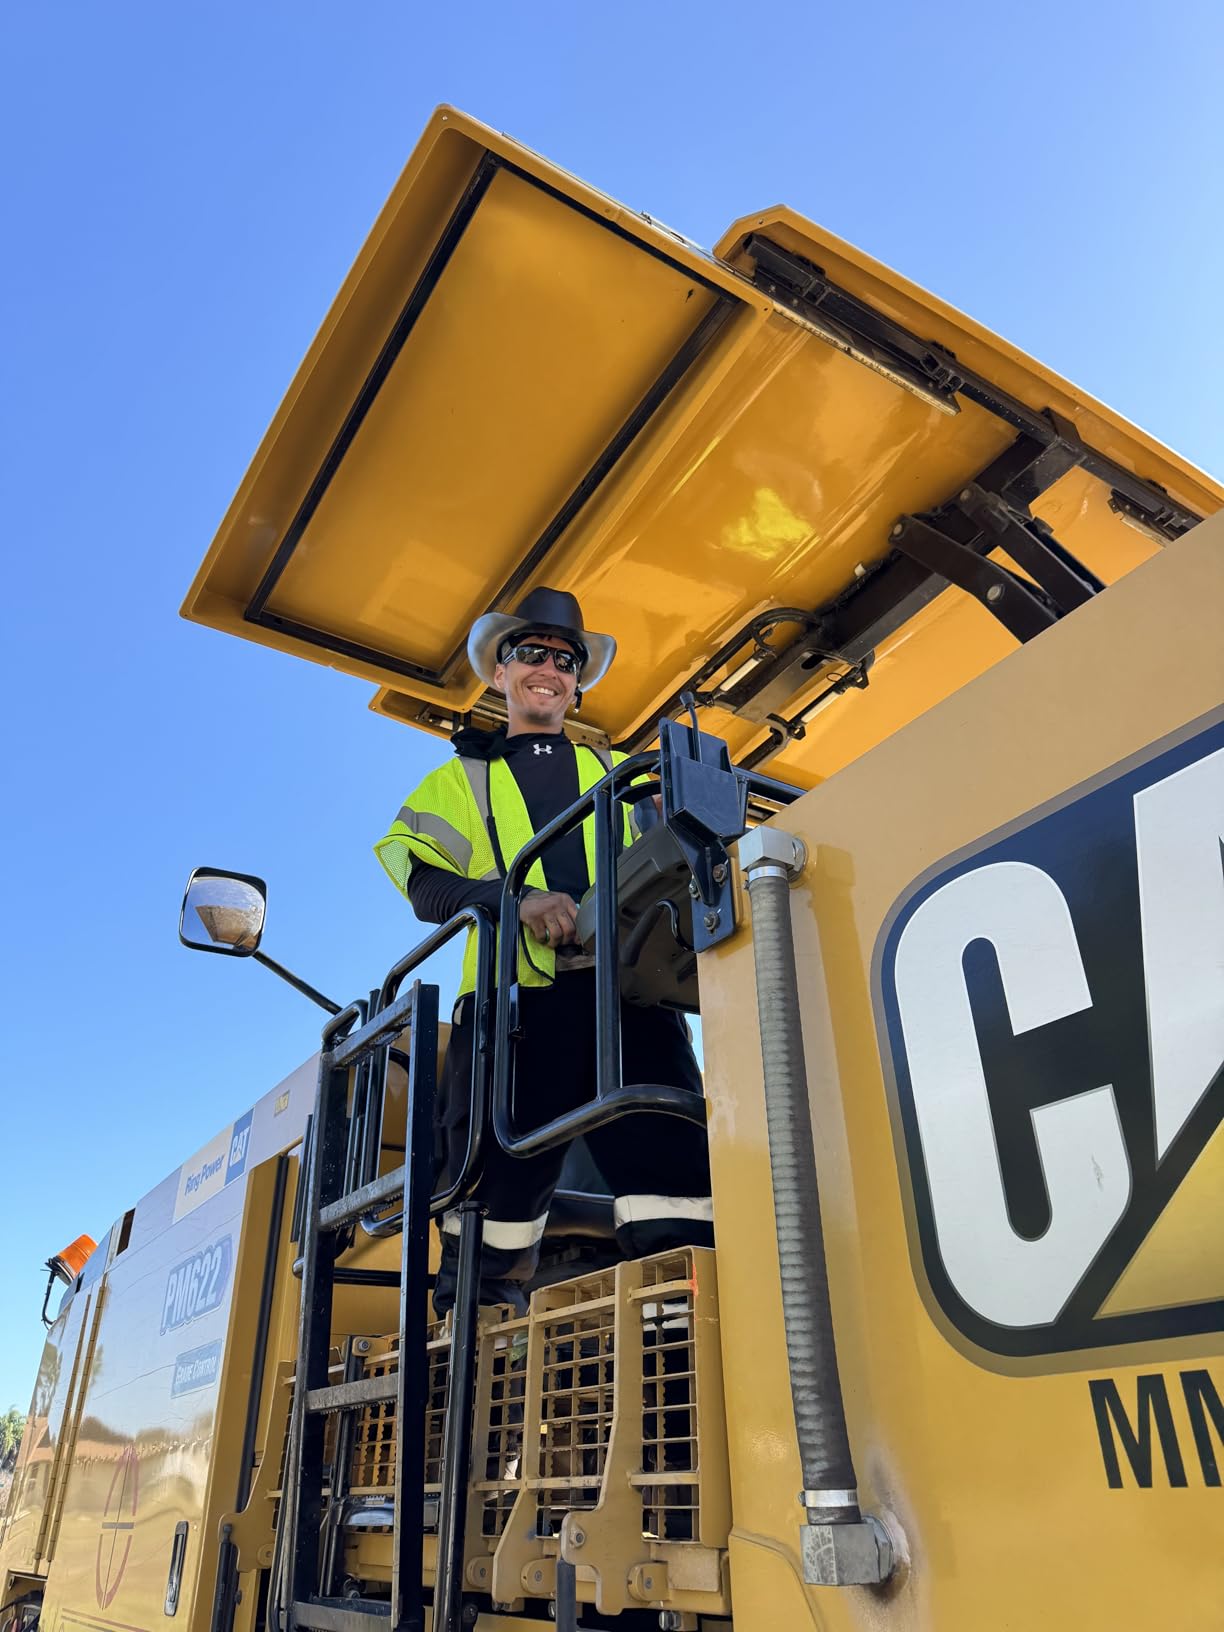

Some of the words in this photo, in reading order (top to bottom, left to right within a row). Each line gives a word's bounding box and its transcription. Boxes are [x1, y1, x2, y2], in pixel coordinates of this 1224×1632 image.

[229, 1126, 251, 1168] CAT
[184, 1173, 201, 1197] Ring
[200, 1153, 225, 1185] Power
[161, 1245, 223, 1331] PM622
